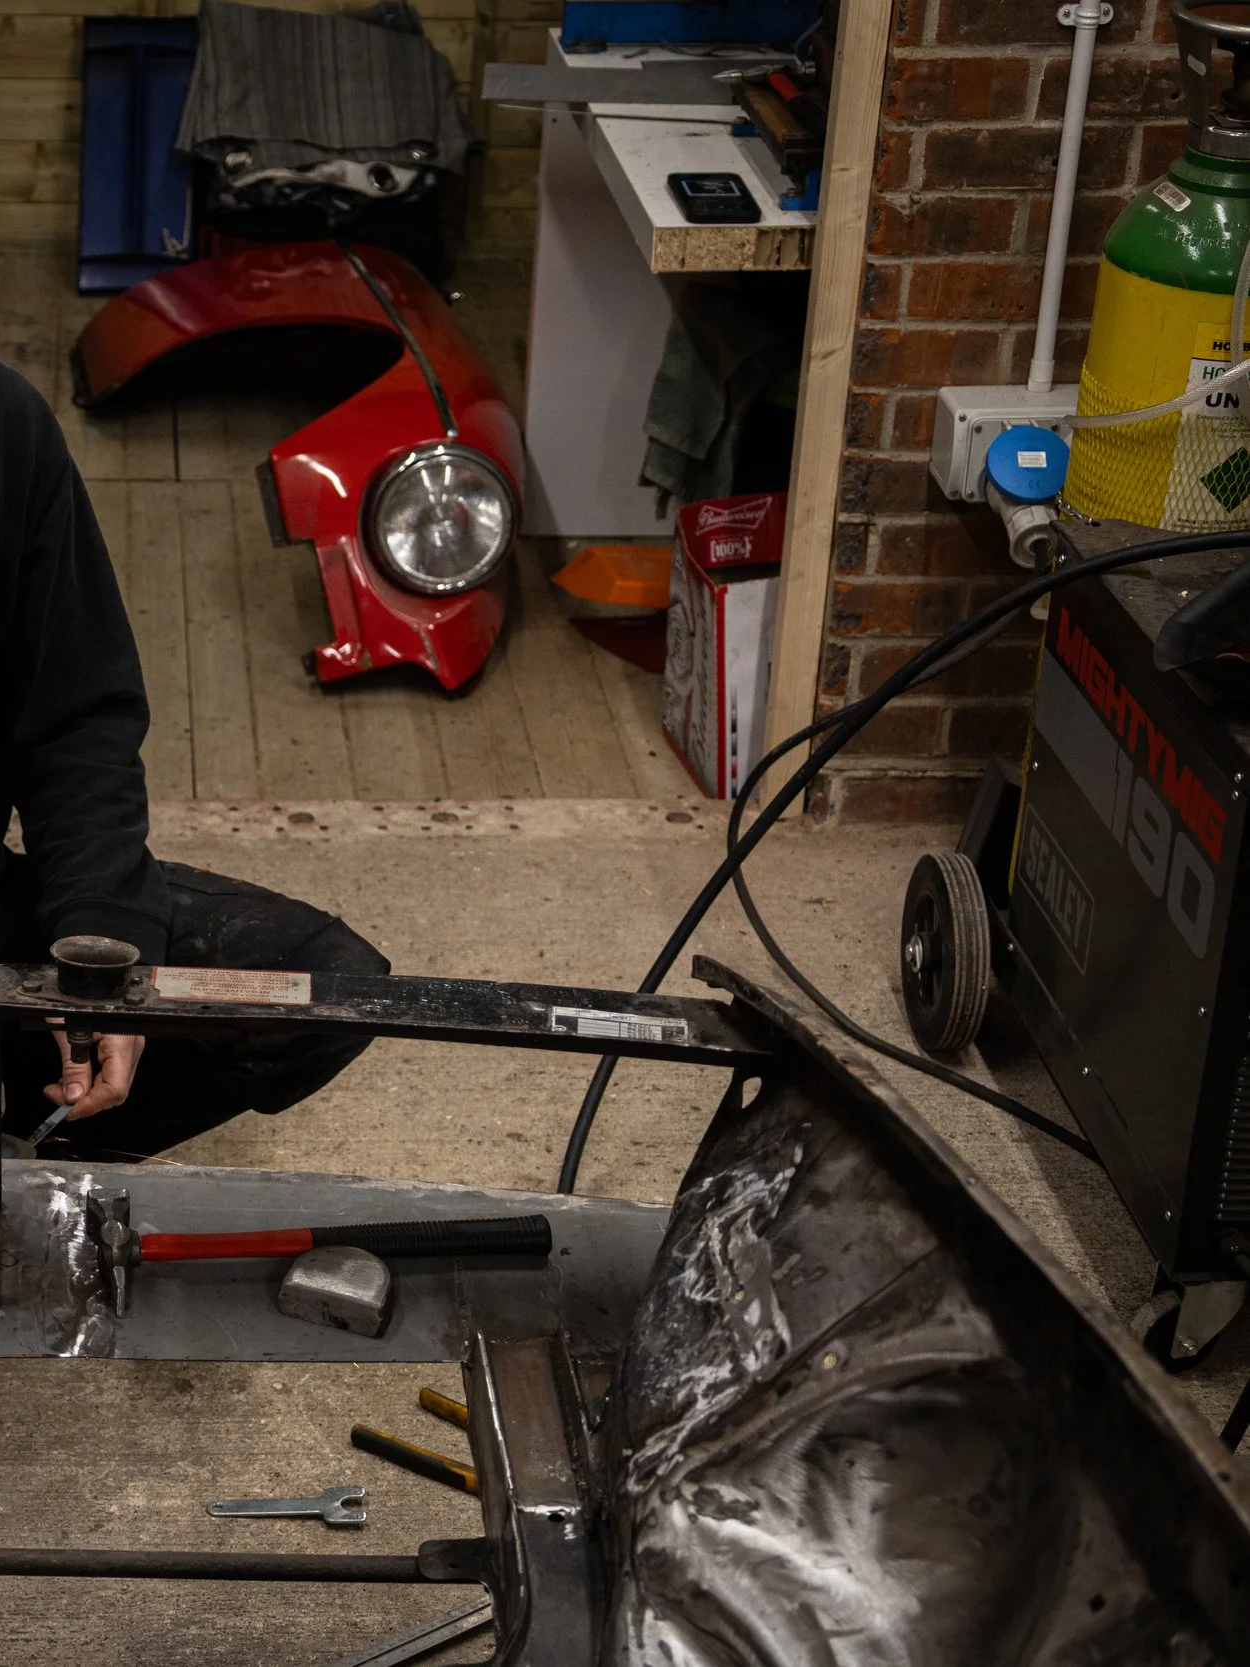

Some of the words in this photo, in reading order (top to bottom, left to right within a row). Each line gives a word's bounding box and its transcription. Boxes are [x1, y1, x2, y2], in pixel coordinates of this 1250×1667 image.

[1205, 392, 1240, 409] UN
[1055, 606, 1227, 865] MIGHTYMIG
[1025, 828, 1086, 951] SEALEY
[1111, 744, 1216, 959] 190
